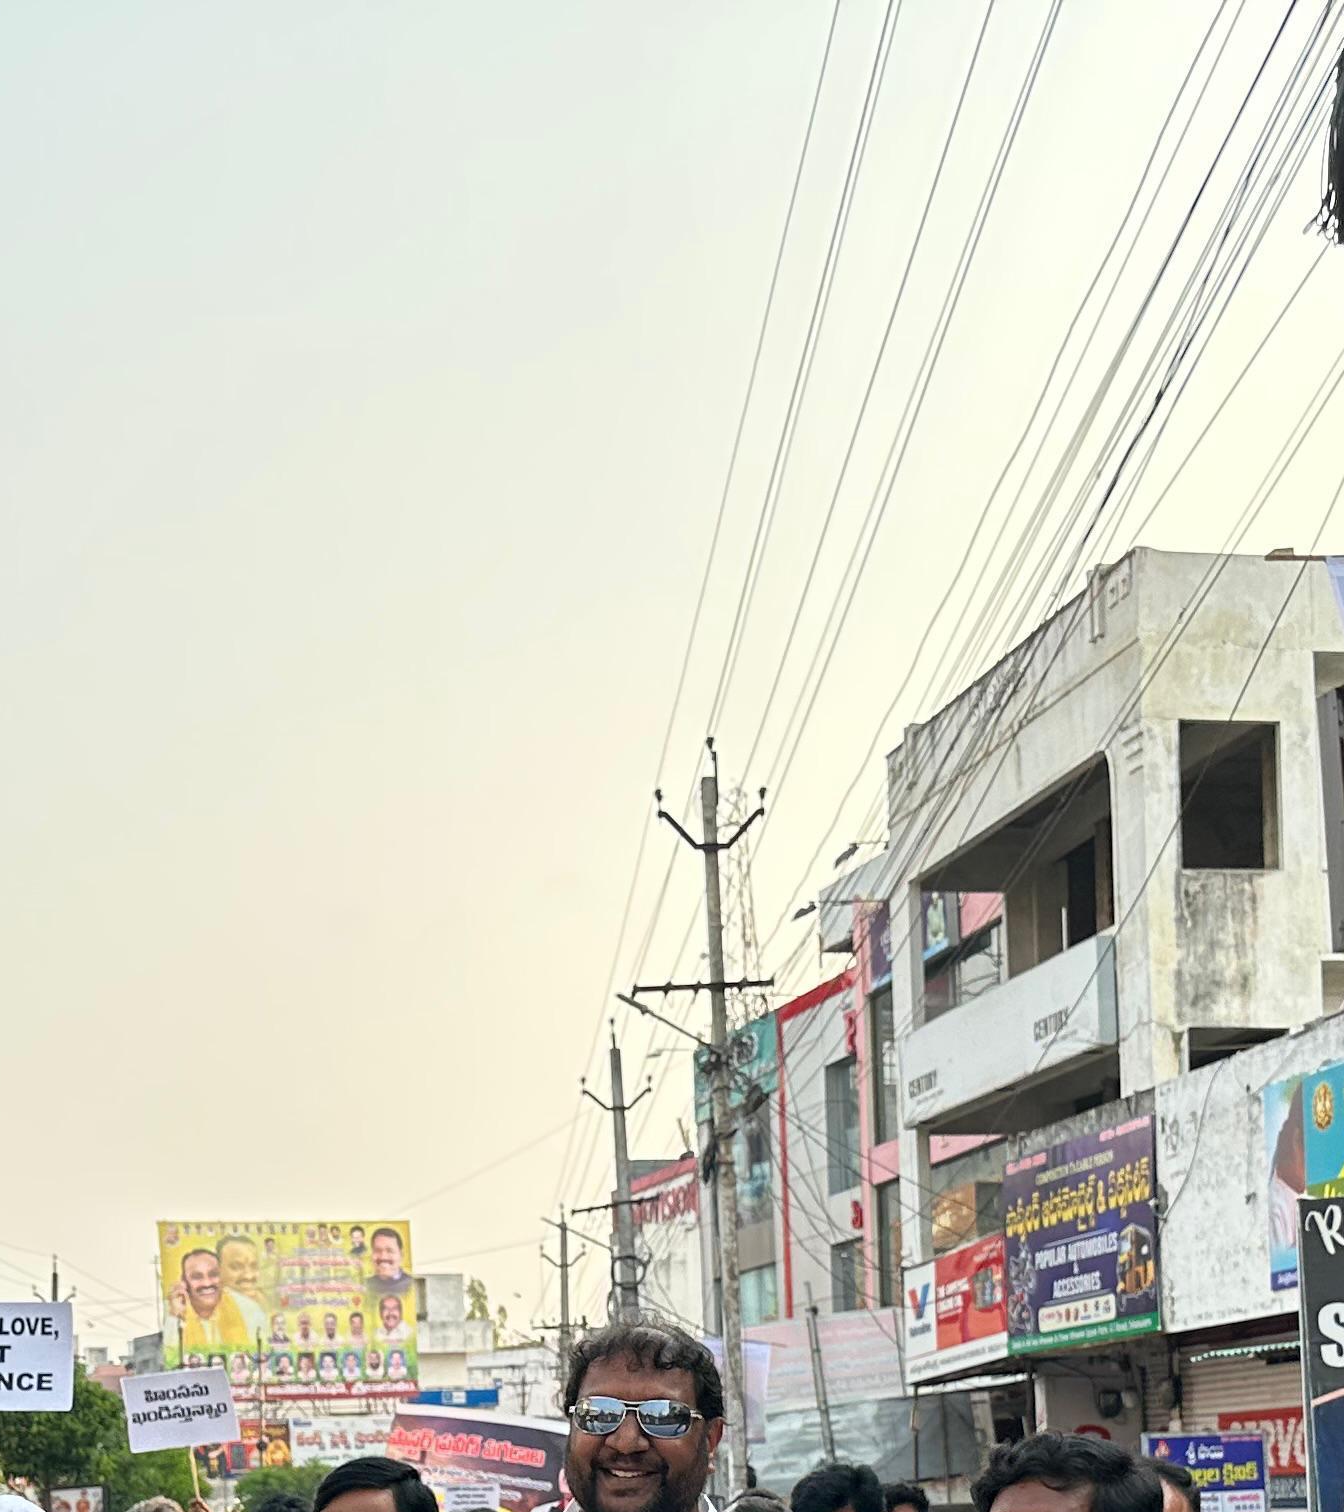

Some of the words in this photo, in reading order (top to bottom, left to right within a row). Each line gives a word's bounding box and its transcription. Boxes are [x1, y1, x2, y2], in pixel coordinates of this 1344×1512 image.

[1033, 1006, 1070, 1042] CENTURY
[908, 1069, 938, 1099] CENTURY
[0, 1317, 60, 1341] LOVE,
